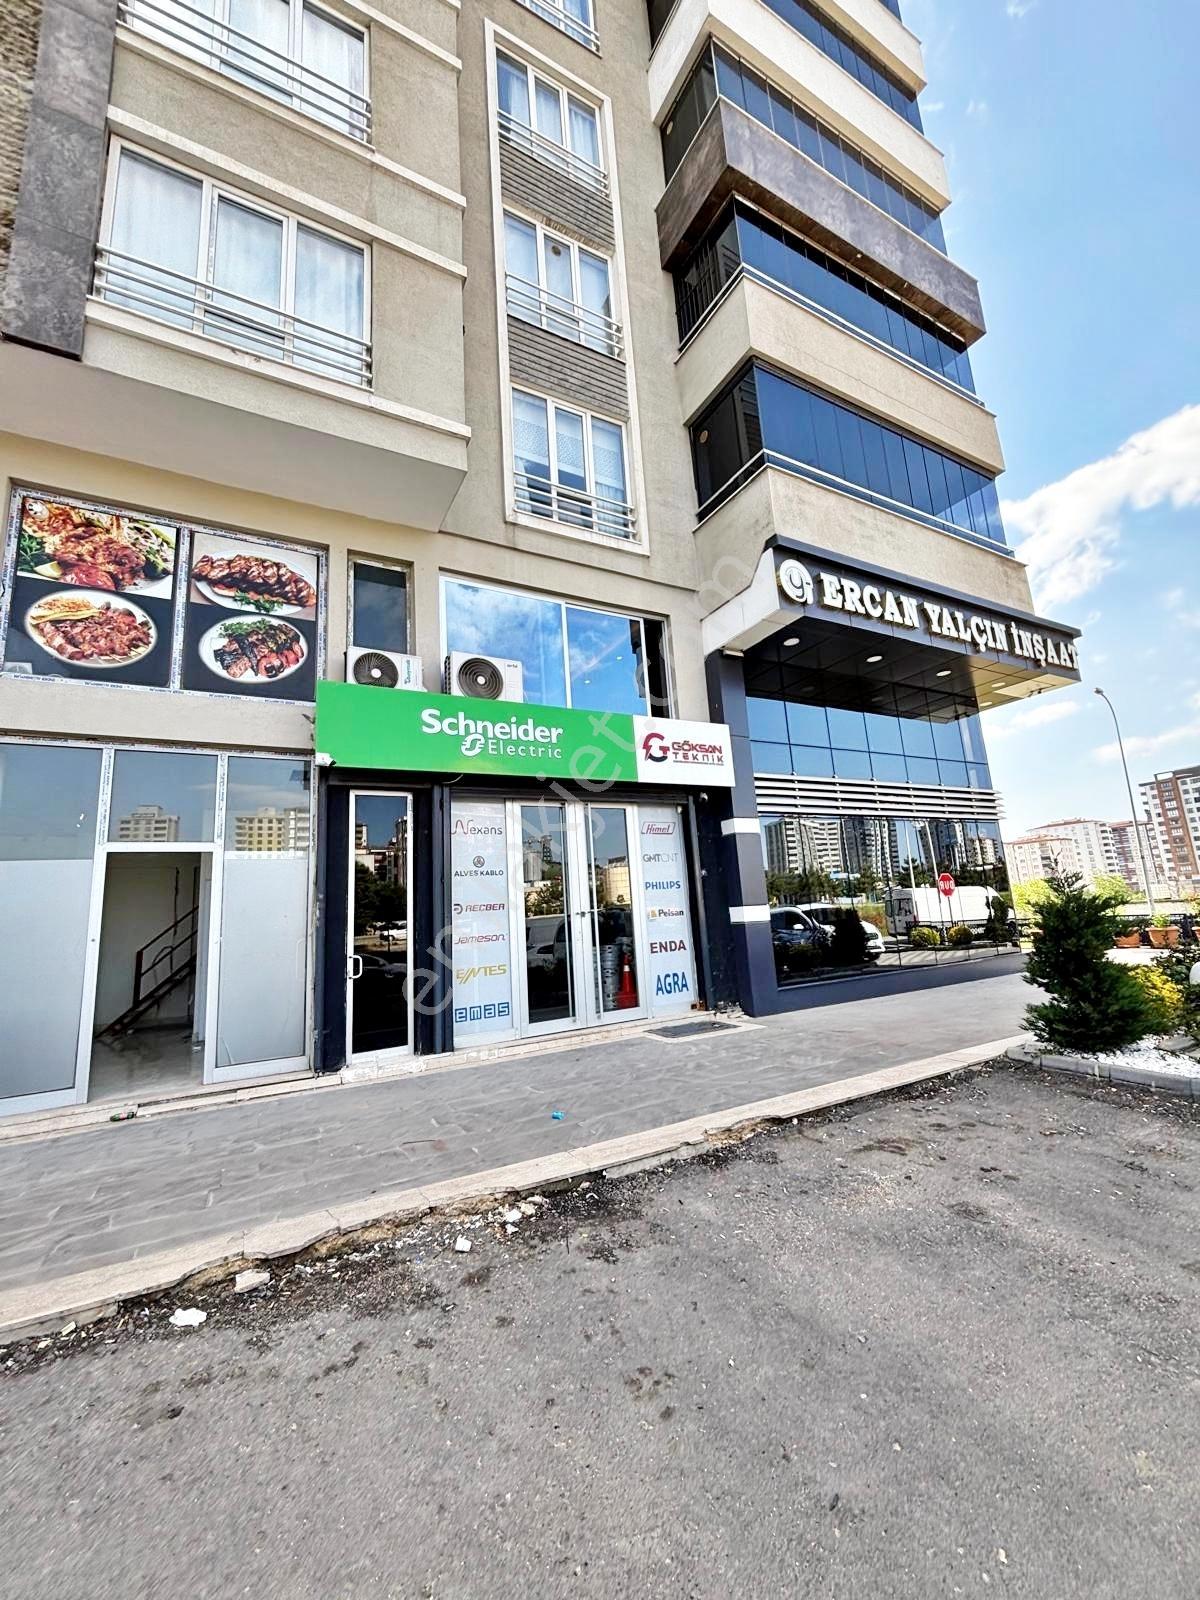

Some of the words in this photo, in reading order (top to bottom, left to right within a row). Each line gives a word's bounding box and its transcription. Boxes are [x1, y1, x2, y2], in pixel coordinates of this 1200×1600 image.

[819, 572, 920, 628] ERCAN
[923, 602, 1009, 652] YALÇIN
[1012, 622, 1079, 667] İNŞAAT
[421, 708, 563, 743] Schneider
[488, 739, 562, 759] Electric
[671, 740, 723, 754] GÖKSAN
[450, 819, 503, 836] Nexans
[645, 881, 681, 890] PHILIPS
[649, 939, 687, 954] ENDA
[656, 971, 689, 996] AGRA
